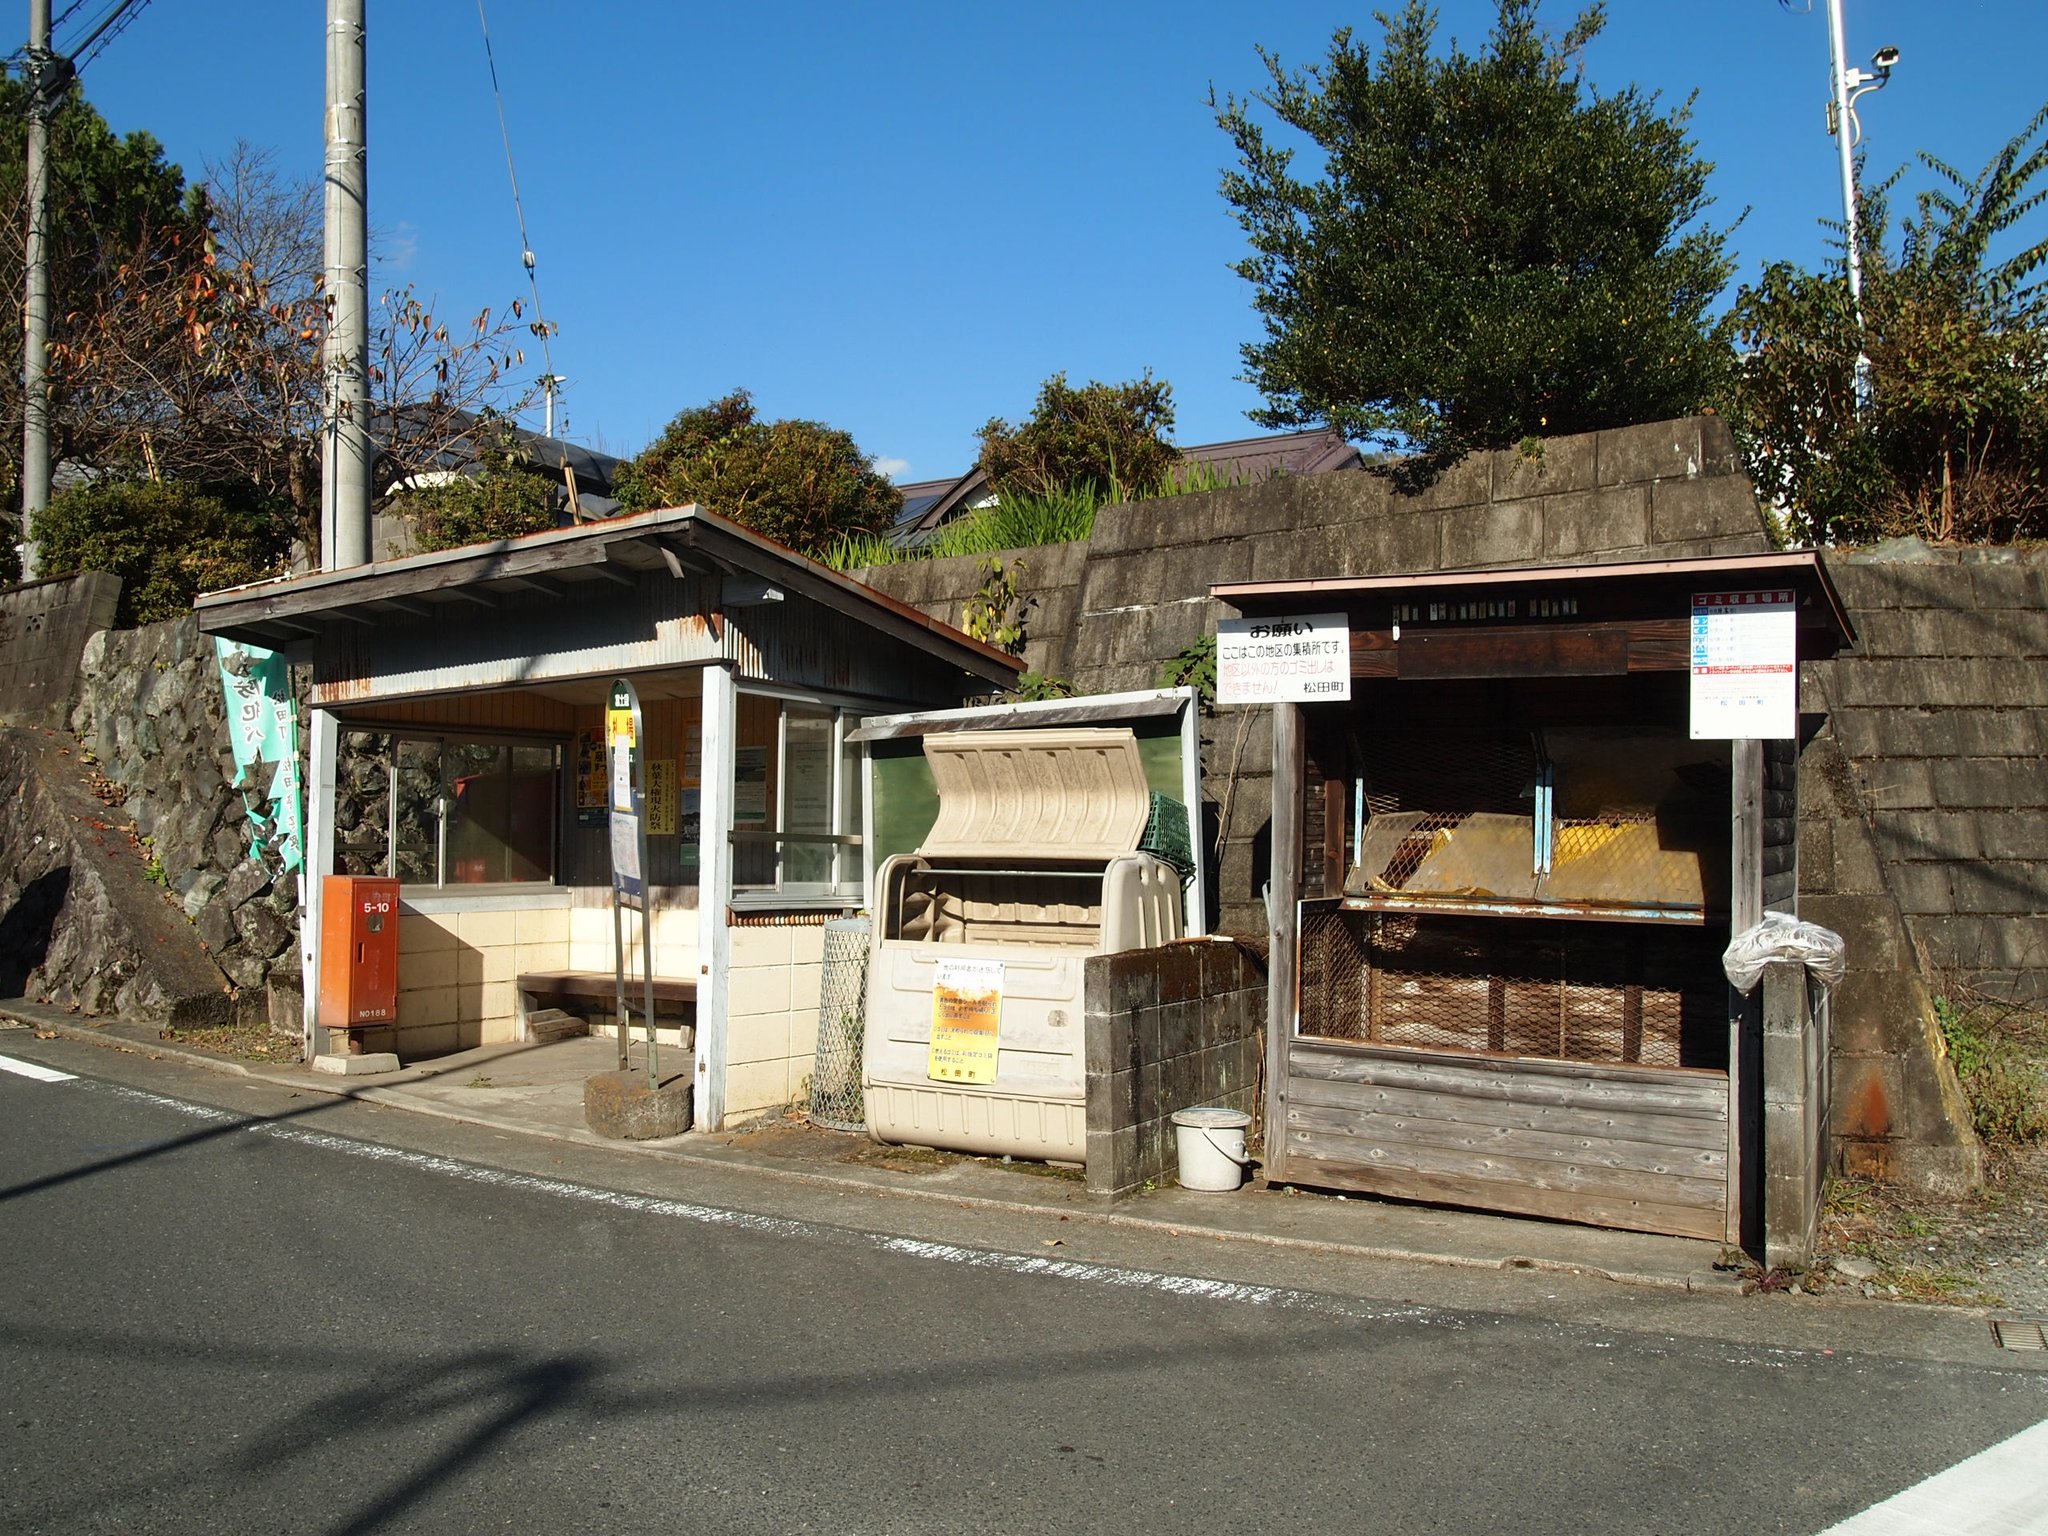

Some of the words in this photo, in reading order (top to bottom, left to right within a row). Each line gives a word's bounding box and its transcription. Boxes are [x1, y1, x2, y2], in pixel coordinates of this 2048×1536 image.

[1250, 622, 1313, 638] お願い
[1222, 660, 1335, 678] 地区以外の方のゴミ出しは
[1303, 682, 1344, 693] 松田町
[364, 902, 390, 913] 5-10
